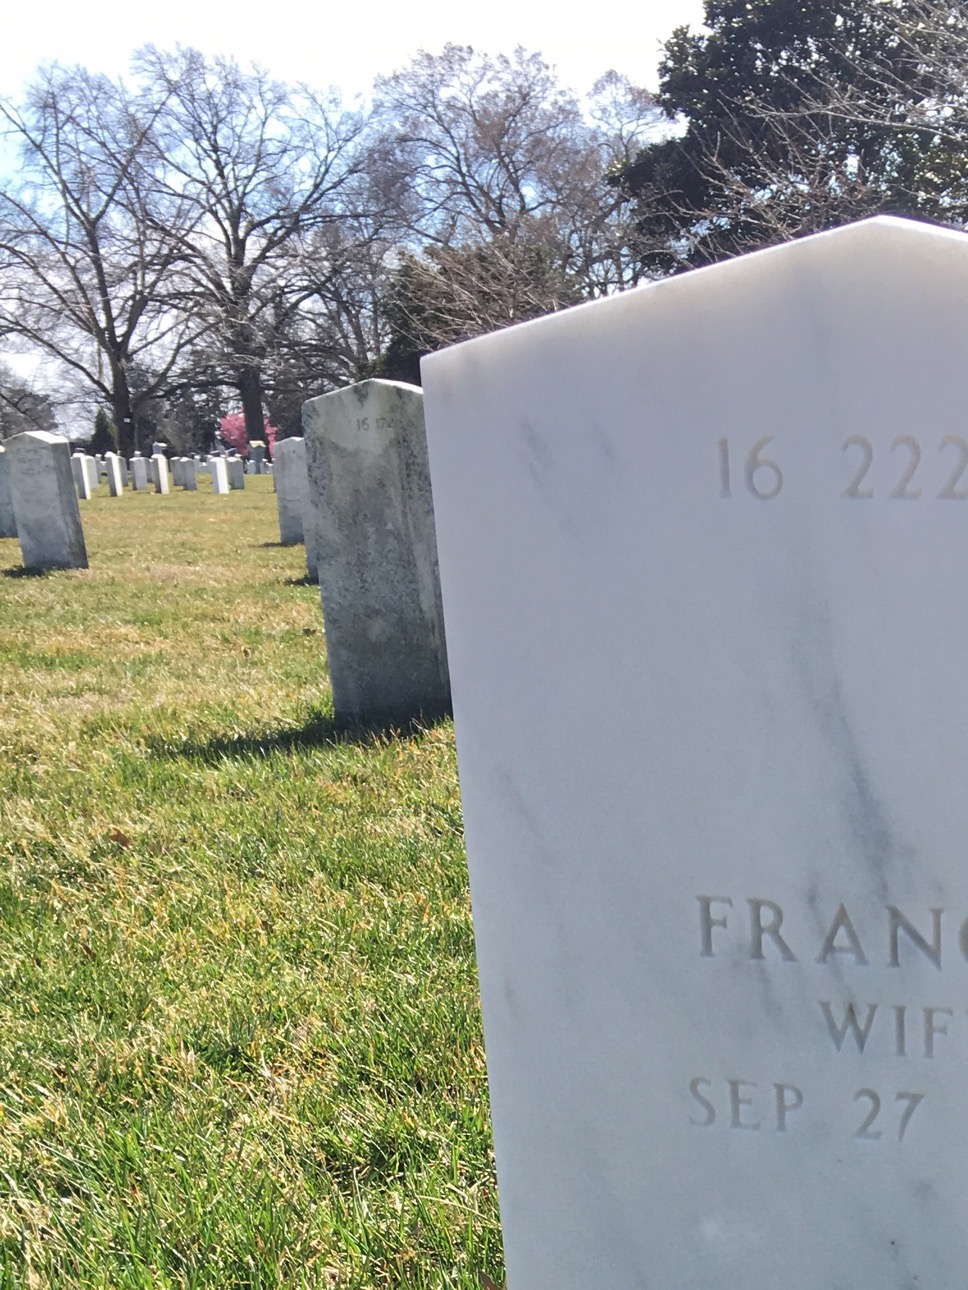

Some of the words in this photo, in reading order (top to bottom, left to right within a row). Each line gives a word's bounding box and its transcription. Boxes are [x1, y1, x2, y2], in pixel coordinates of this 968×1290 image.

[717, 435, 784, 500] 16
[688, 1076, 803, 1133] SEP
[851, 1087, 926, 1143] 27
